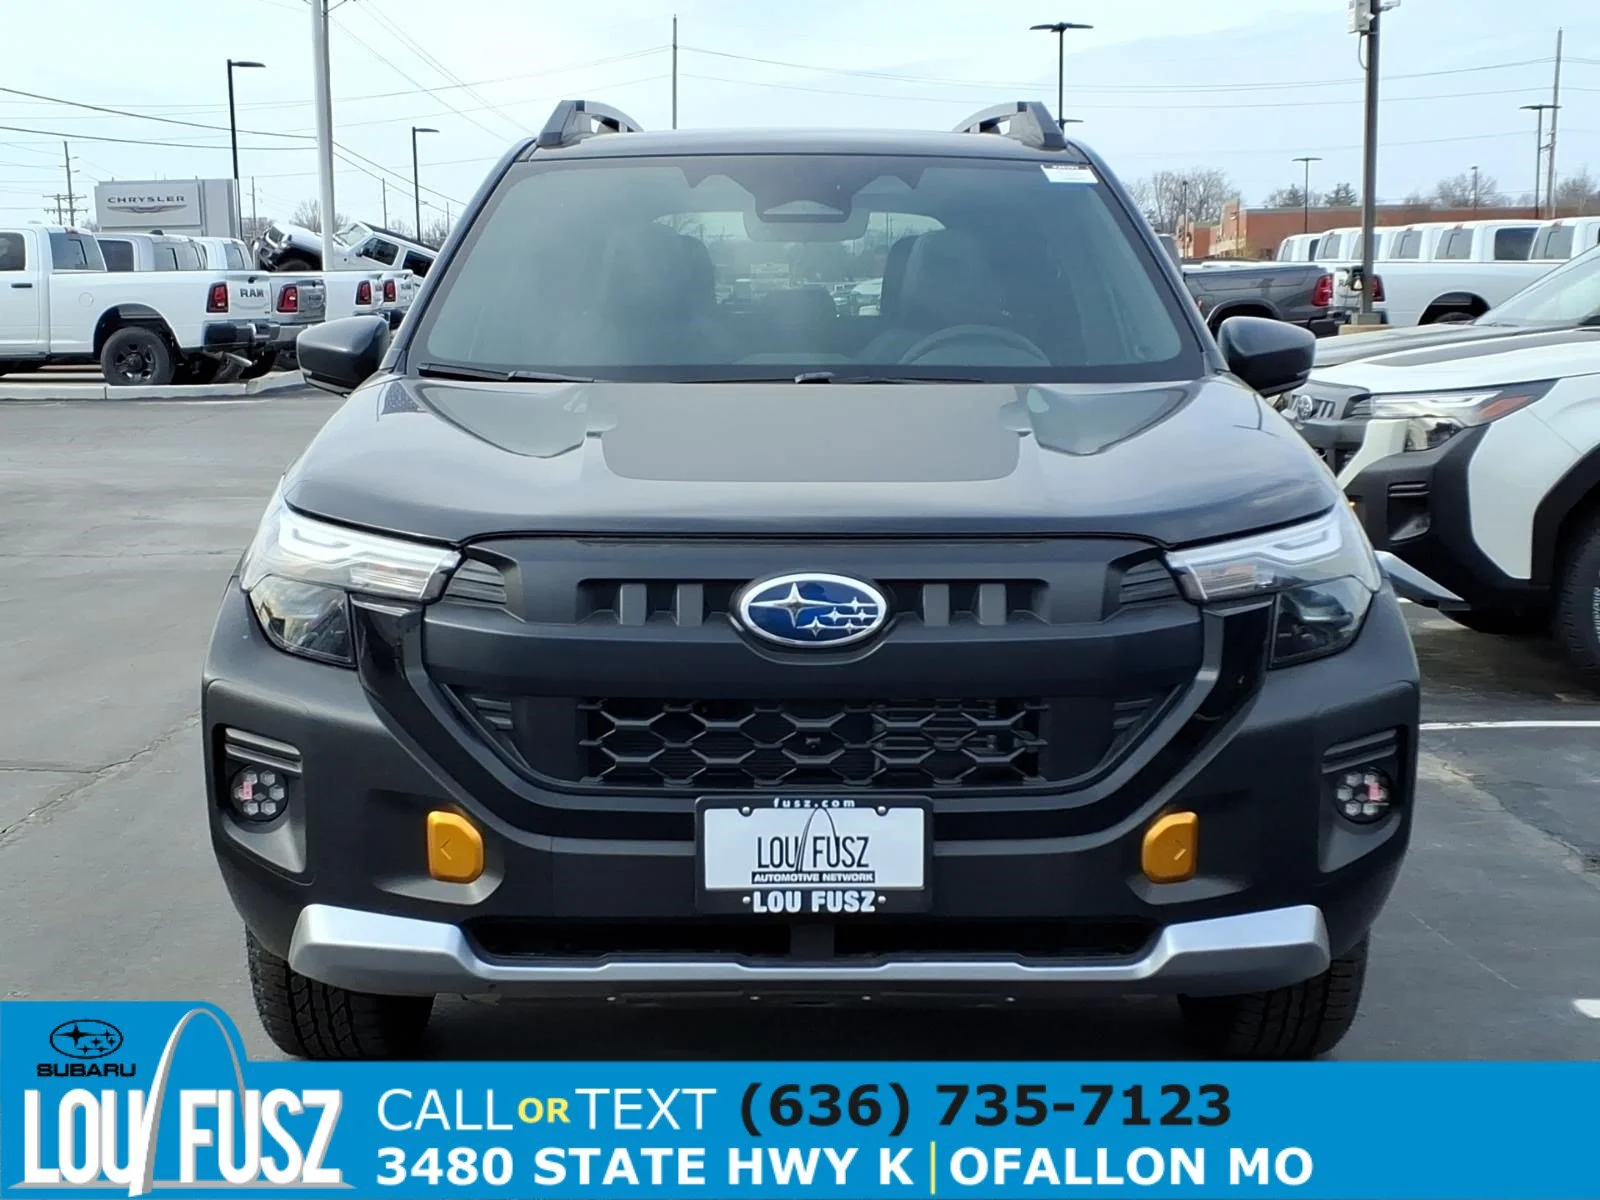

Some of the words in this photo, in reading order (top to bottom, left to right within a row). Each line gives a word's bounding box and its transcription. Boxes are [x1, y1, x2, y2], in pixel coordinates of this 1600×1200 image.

[107, 195, 185, 204] CHRYSLER
[240, 287, 265, 298] RAM
[773, 797, 856, 809] fusz.com
[757, 836, 800, 869] LOU
[812, 836, 870, 869] FUSZ
[753, 872, 820, 883] AUTOMOTIVE
[822, 872, 874, 883] NETWORK
[753, 890, 802, 914] LOU
[811, 890, 876, 914] FUSZ
